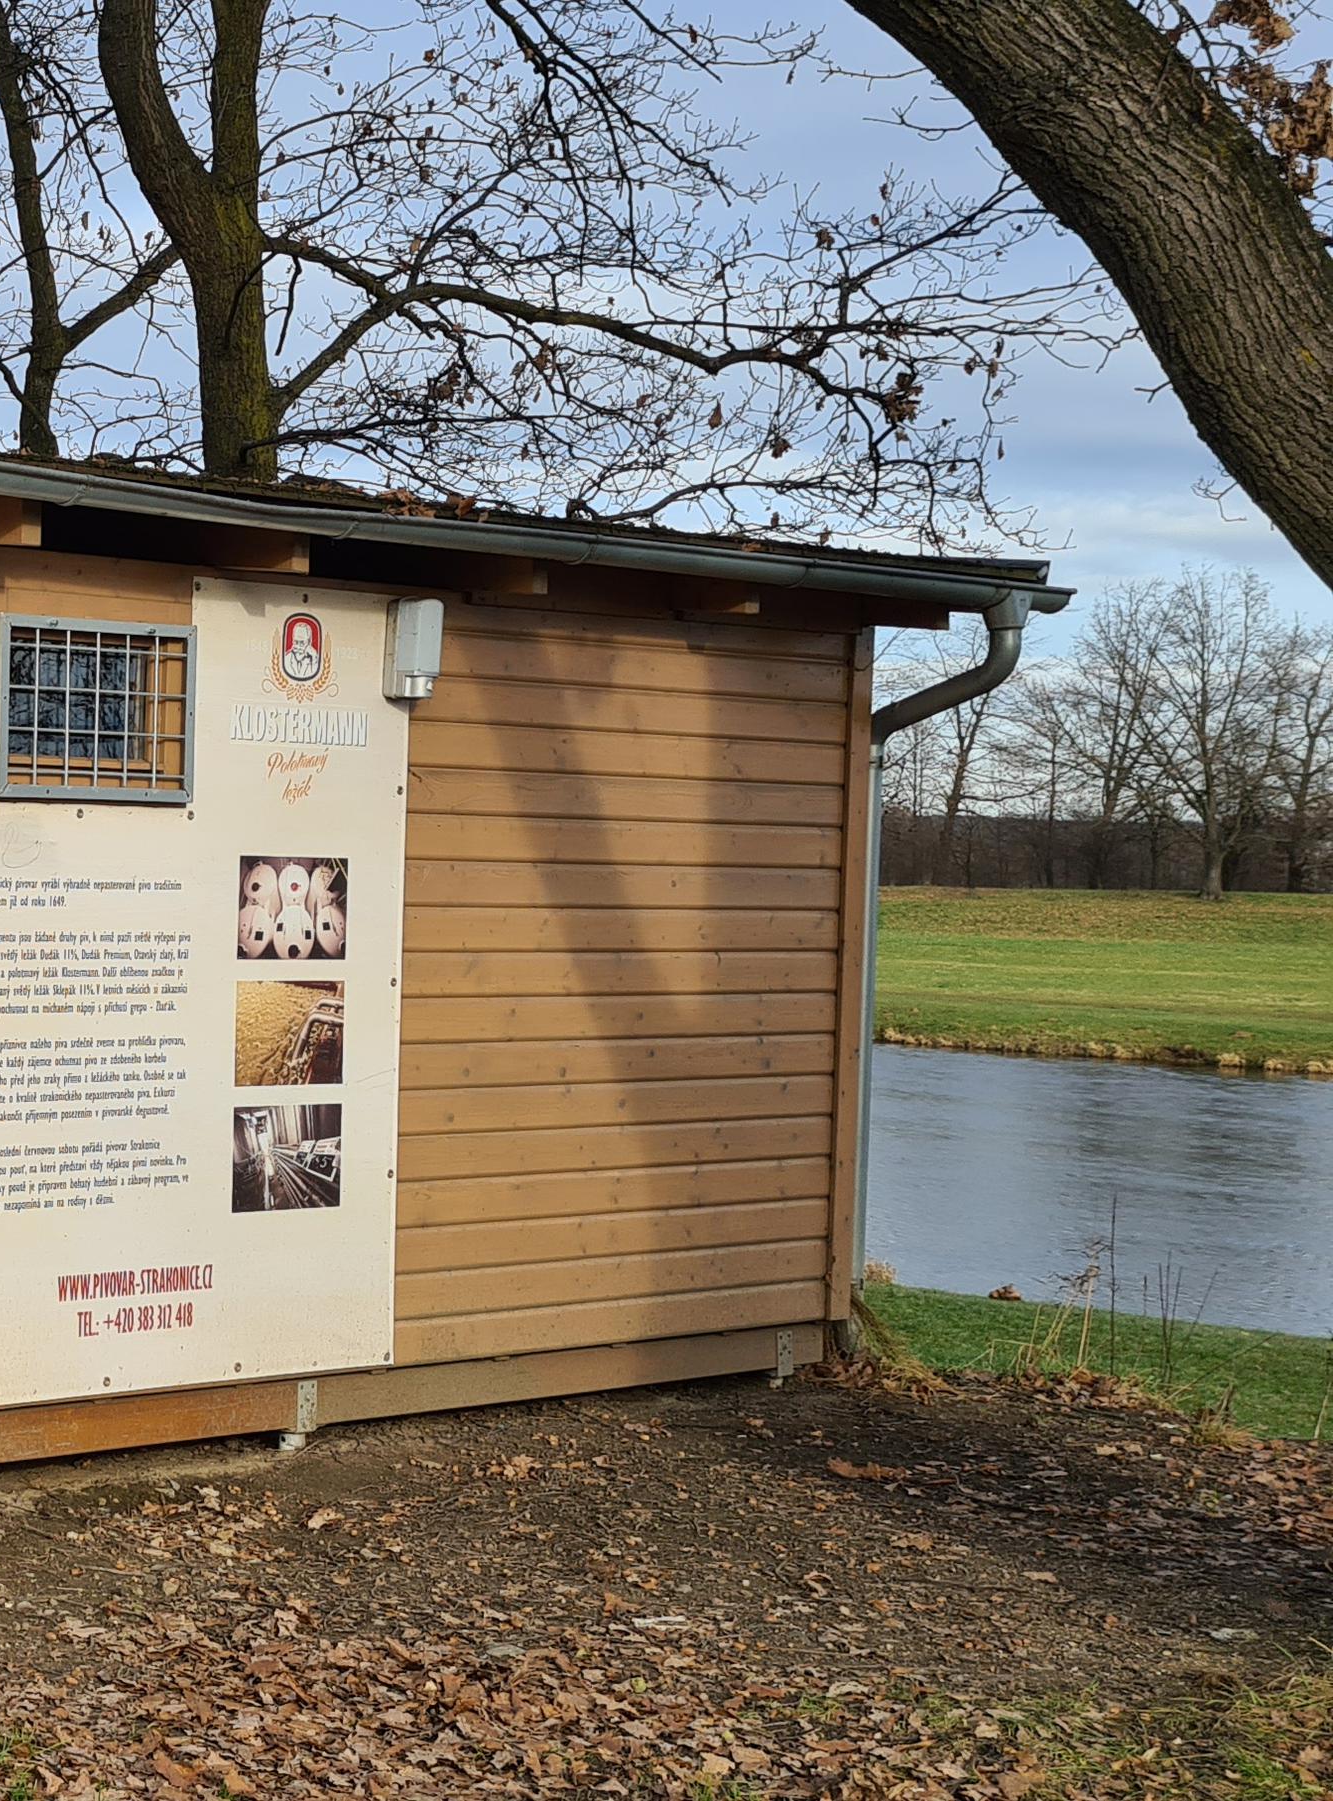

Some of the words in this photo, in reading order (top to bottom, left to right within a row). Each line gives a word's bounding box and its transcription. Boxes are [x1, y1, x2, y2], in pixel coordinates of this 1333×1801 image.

[231, 704, 368, 747] KLOSTERMANN
[267, 747, 329, 778] Polotmavý
[282, 774, 312, 804] ležák
[49, 894, 68, 907] 1649.
[58, 1264, 212, 1303] WWW.PIVOVAR-STRAKONICE.CZ
[103, 1306, 133, 1335] +420
[136, 1304, 154, 1332] 383
[155, 1302, 172, 1330] 312
[175, 1301, 193, 1329] 418
